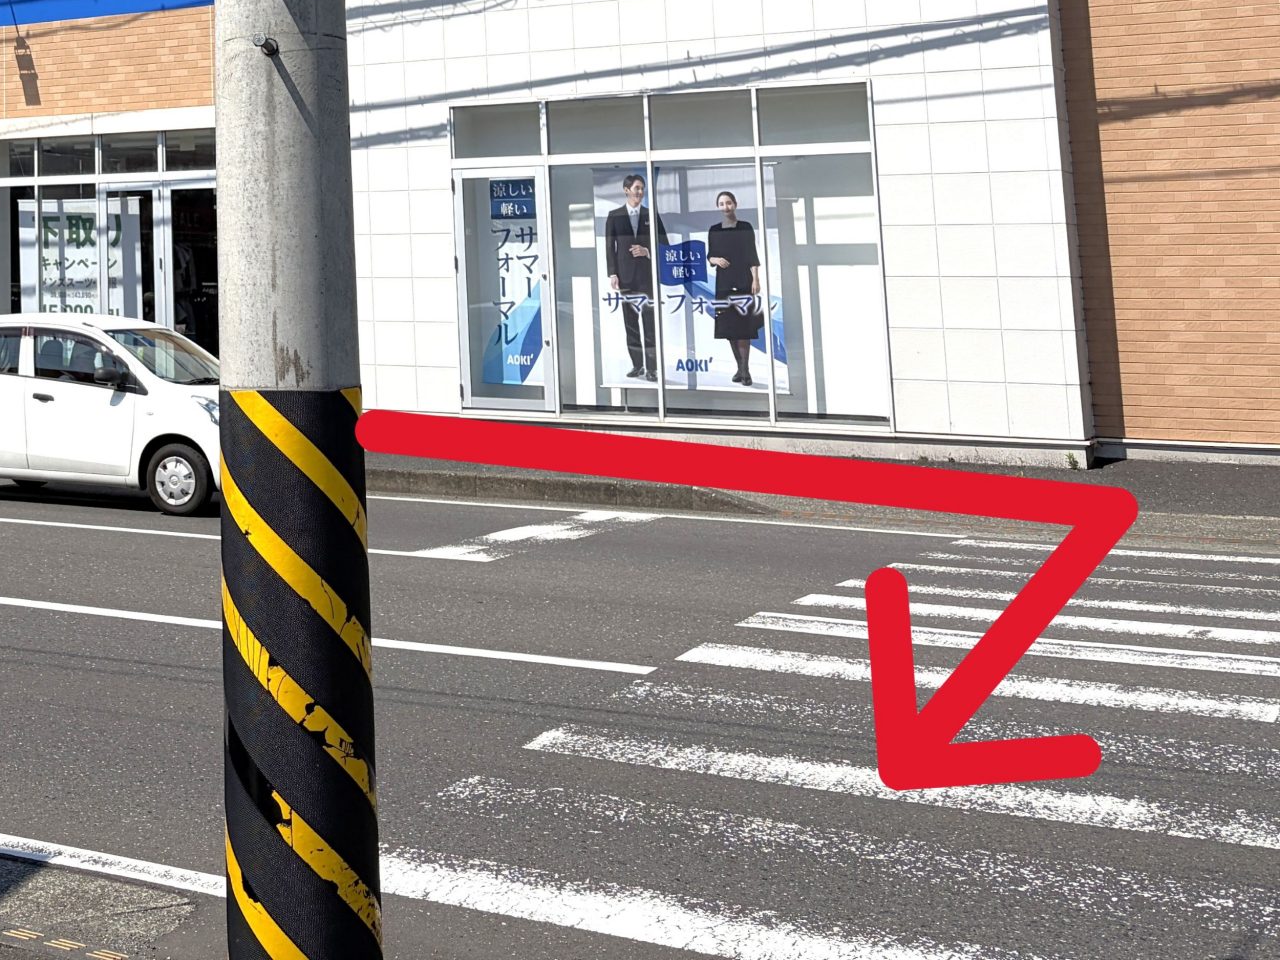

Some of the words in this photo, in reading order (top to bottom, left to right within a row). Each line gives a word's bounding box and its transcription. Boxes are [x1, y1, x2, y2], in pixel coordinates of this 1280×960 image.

[492, 182, 534, 198] 涼しい
[500, 202, 528, 217] 軽い
[515, 225, 539, 298] サマー
[665, 249, 701, 262] 涼しい
[672, 266, 696, 279] 軽い
[491, 227, 519, 346] フォーマル
[602, 291, 778, 316] サマーフォーマル
